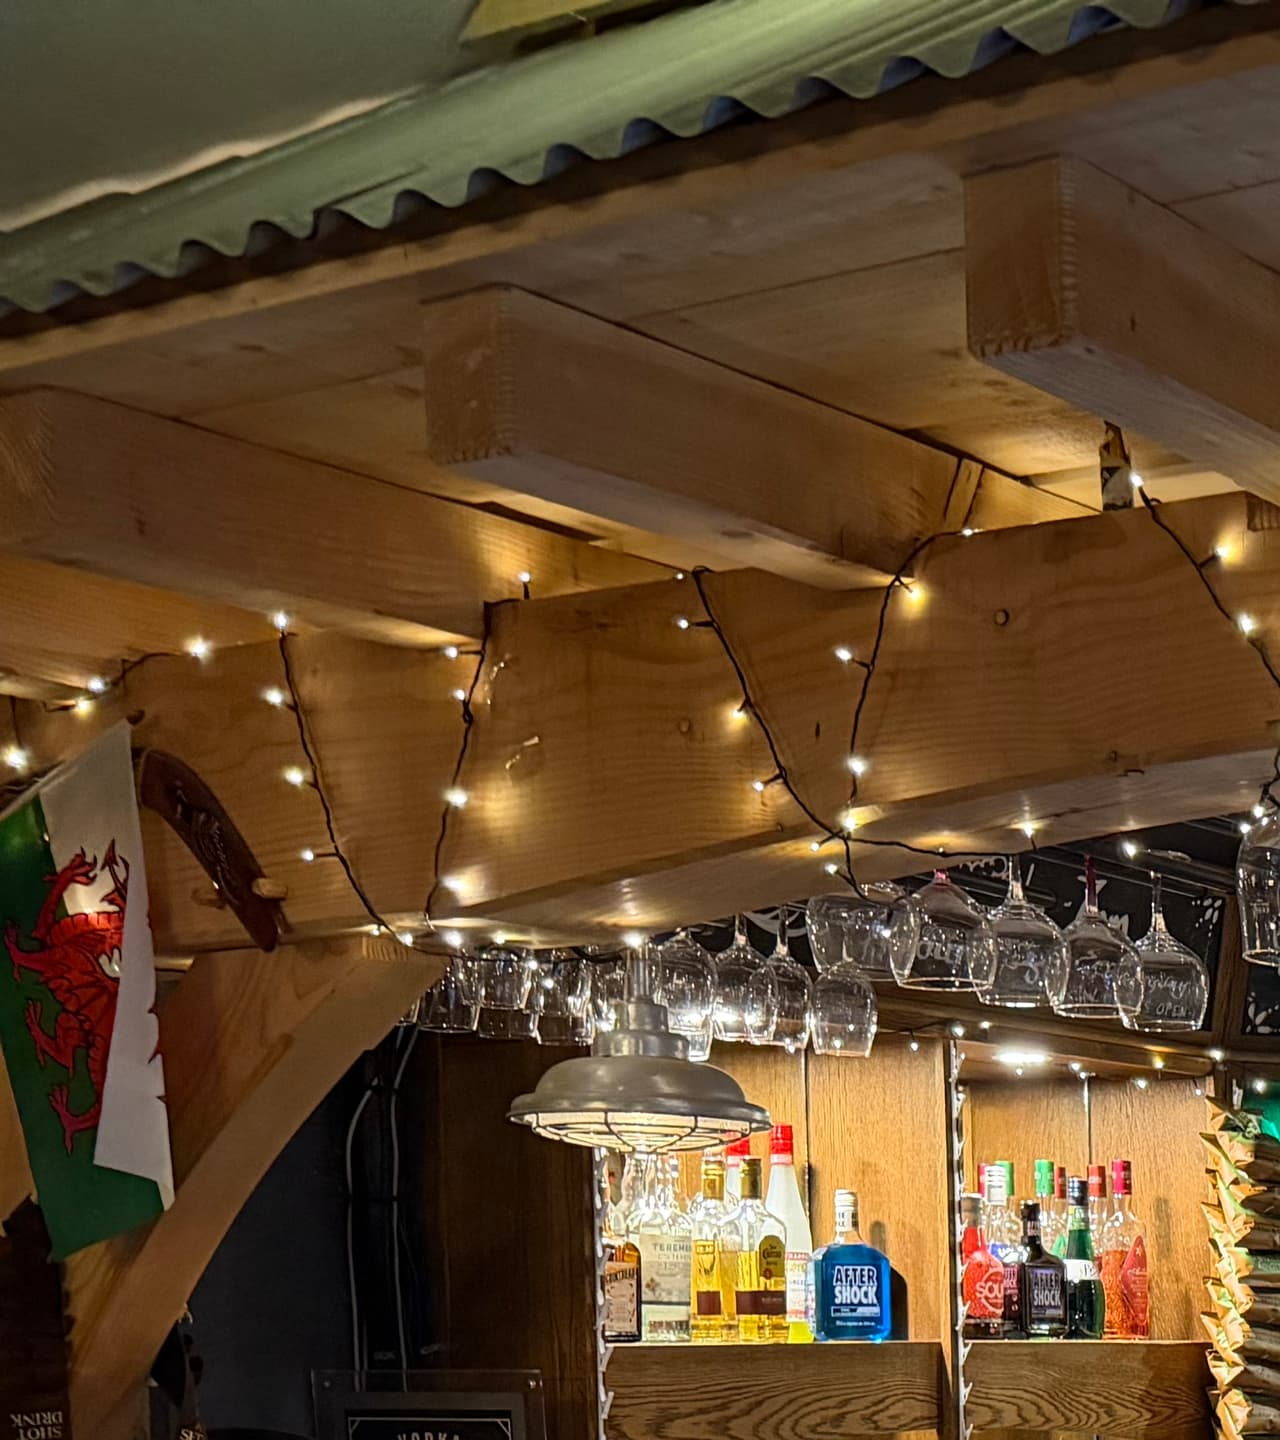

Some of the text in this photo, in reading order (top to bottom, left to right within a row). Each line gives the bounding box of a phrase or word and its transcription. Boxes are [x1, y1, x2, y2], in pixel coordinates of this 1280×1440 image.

[832, 1265, 878, 1287] AFTER
[833, 1284, 879, 1306] SHOCK
[1033, 1289, 1061, 1306] SHOCK
